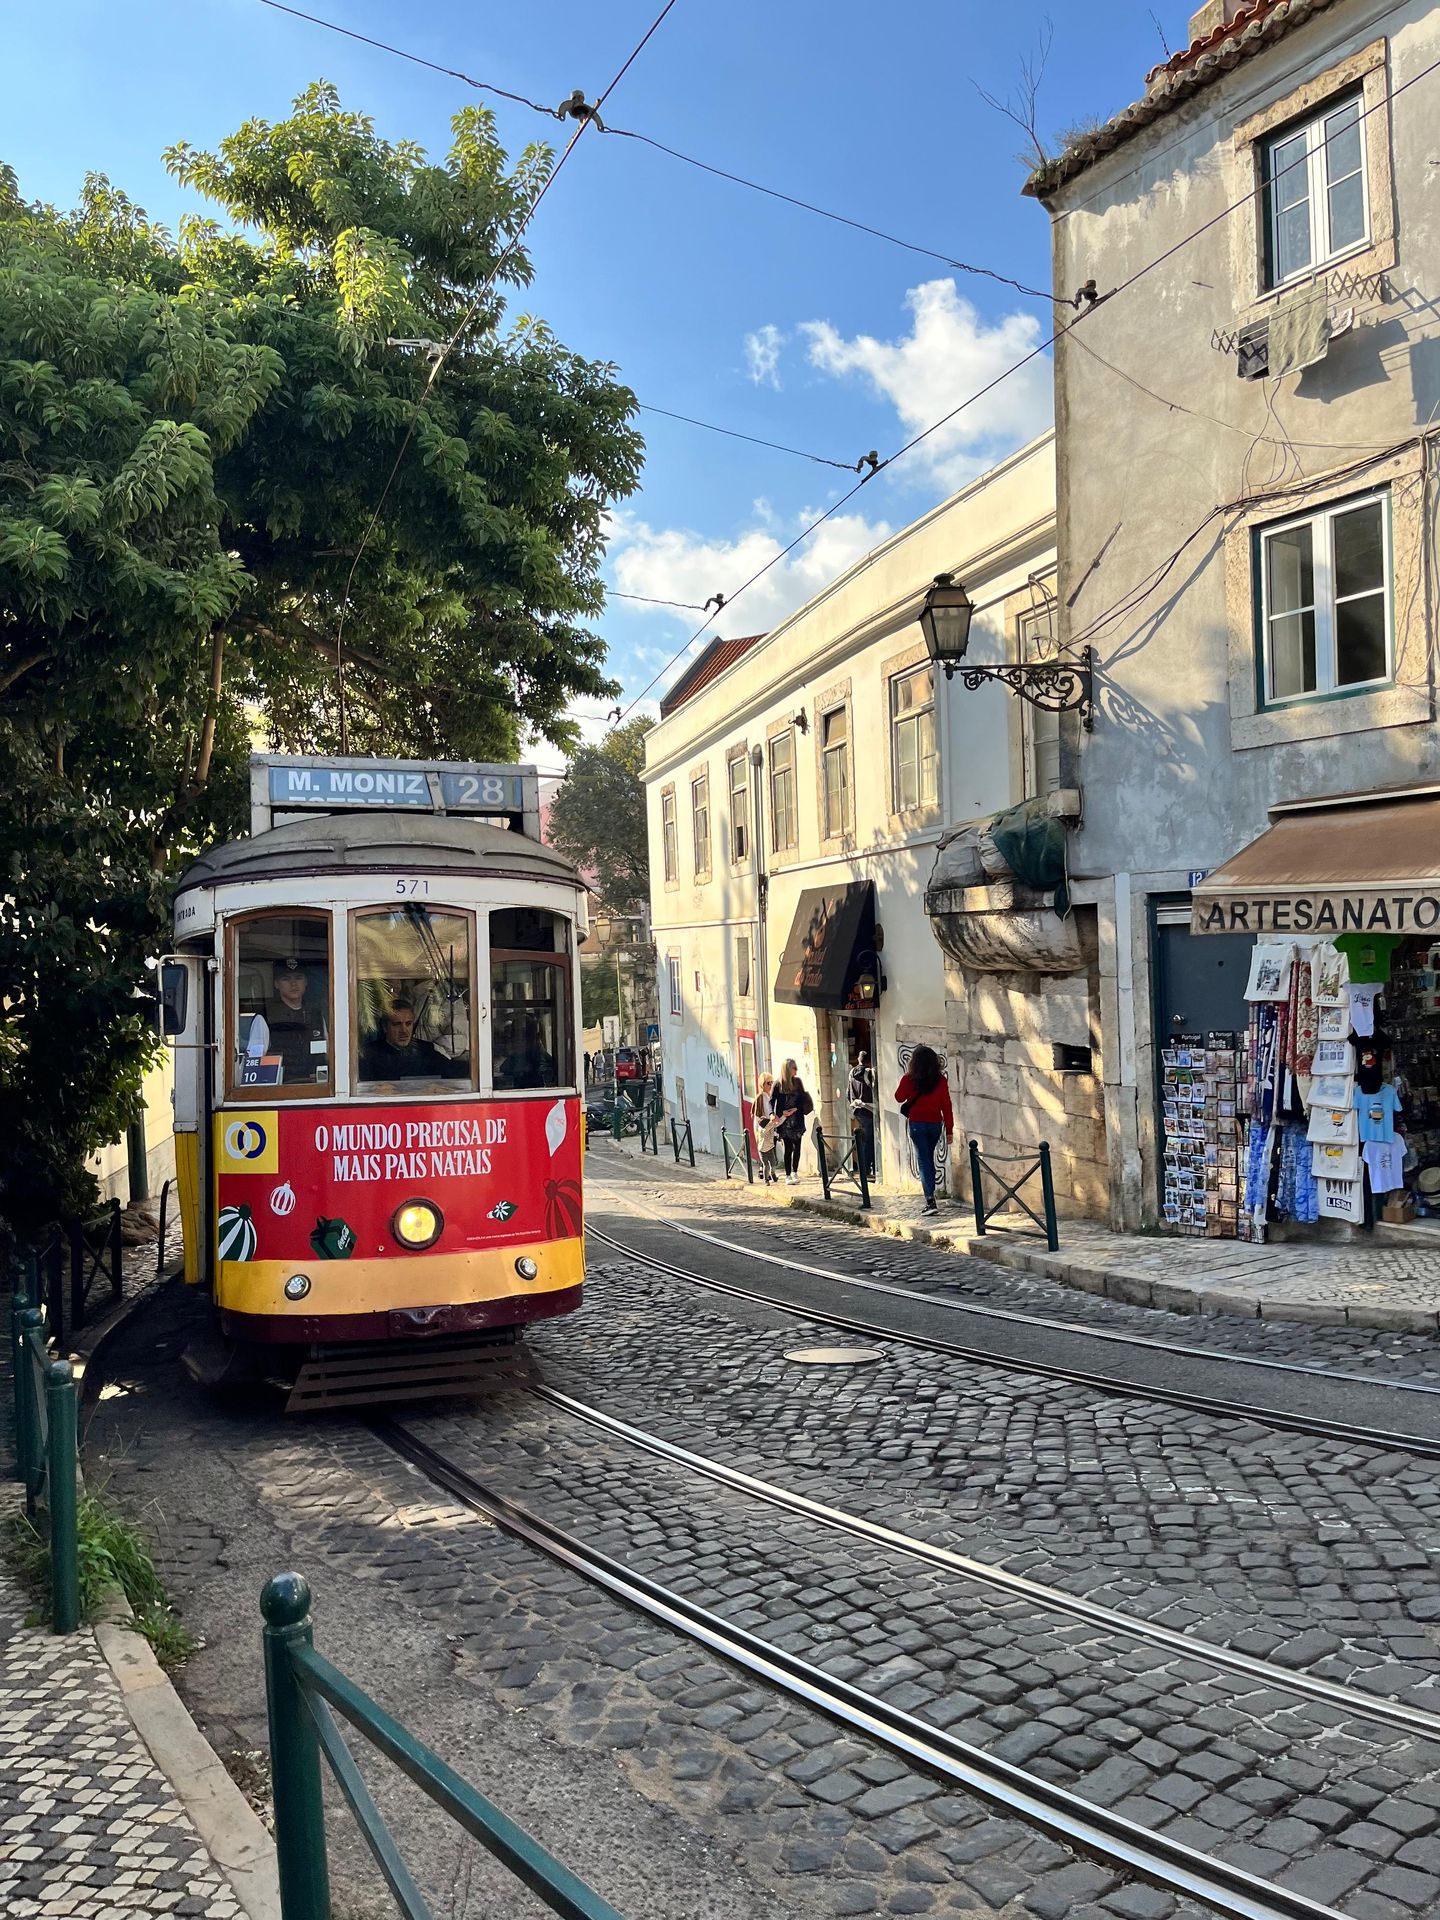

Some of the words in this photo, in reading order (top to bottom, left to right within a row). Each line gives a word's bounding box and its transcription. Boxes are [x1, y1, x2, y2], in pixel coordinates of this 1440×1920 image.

[288, 771, 320, 791] M.
[330, 772, 424, 795] MONIZ
[458, 776, 504, 805] 28
[396, 879, 428, 895] 571
[1206, 896, 1440, 930] ARTESANATO
[245, 1059, 259, 1067] 28E
[244, 1071, 257, 1083] 10
[315, 1125, 329, 1152] O
[332, 1123, 402, 1151] MUNDO
[405, 1119, 482, 1149] PRECISA
[485, 1118, 507, 1145] DE
[333, 1154, 381, 1182] MAIS
[384, 1152, 428, 1180] PAIS
[431, 1149, 492, 1177] NATAIS
